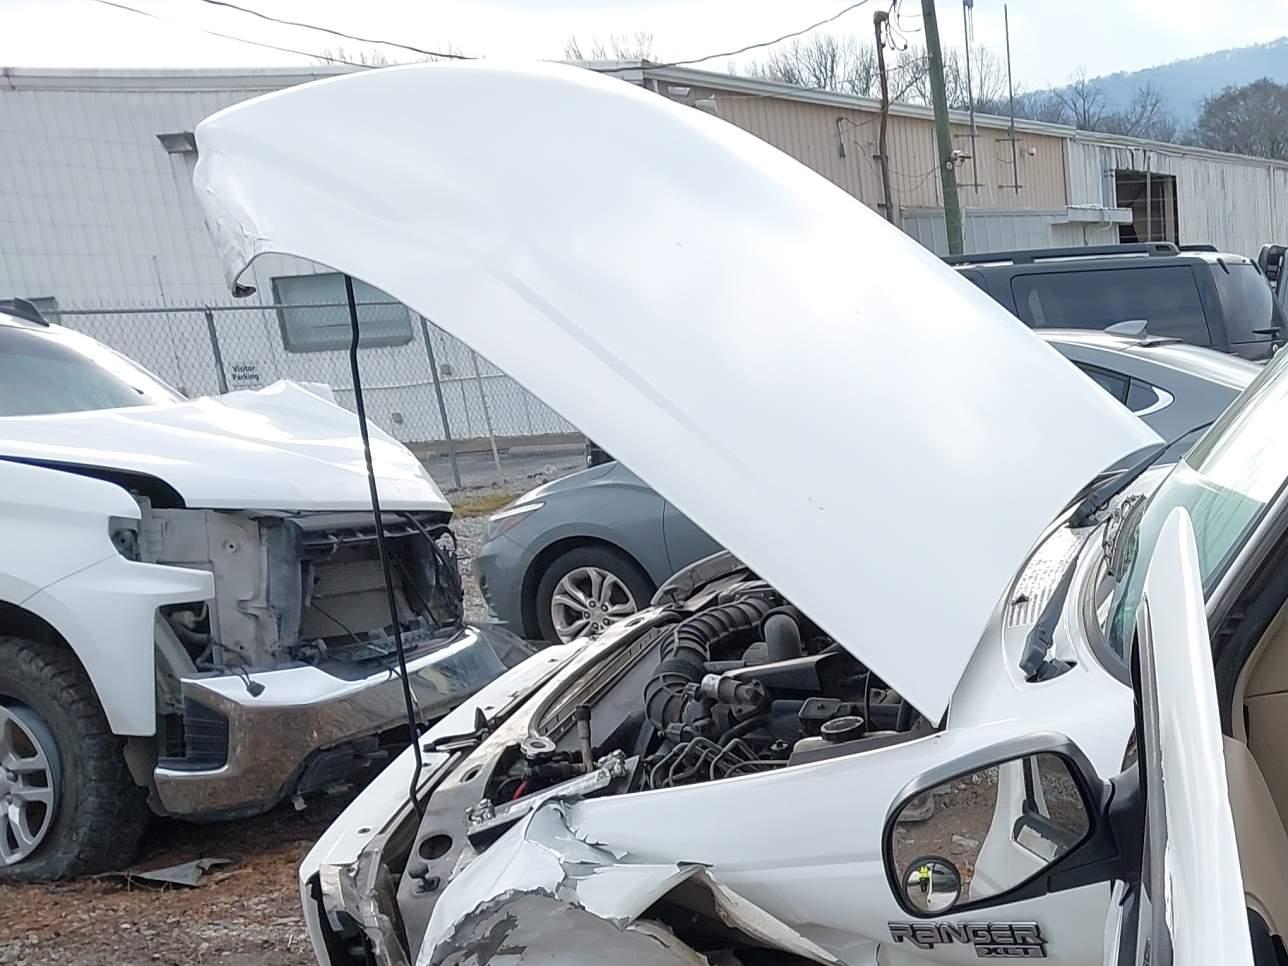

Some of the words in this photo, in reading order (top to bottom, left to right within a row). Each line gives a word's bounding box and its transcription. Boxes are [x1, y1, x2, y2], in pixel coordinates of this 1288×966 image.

[232, 373, 259, 381] Parking
[887, 920, 1048, 950] RANGER
[983, 946, 1034, 956] XLT
